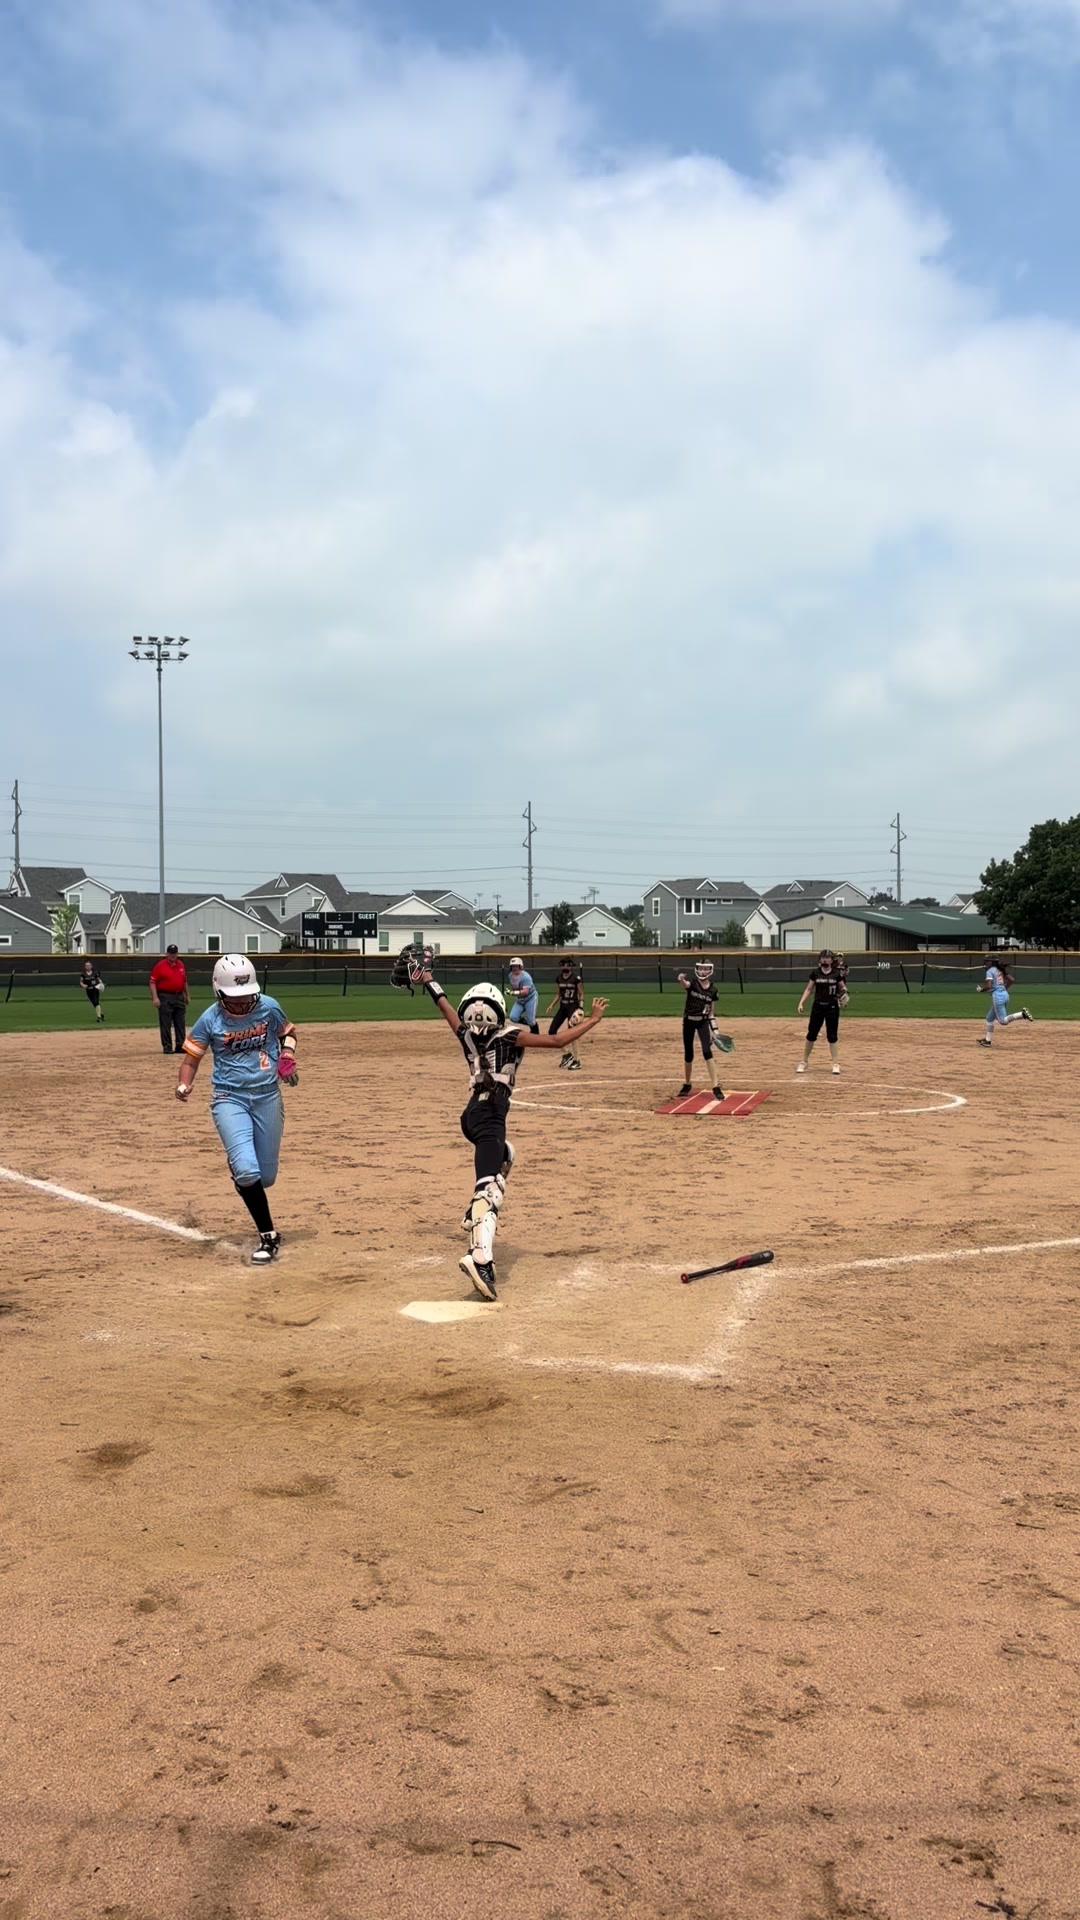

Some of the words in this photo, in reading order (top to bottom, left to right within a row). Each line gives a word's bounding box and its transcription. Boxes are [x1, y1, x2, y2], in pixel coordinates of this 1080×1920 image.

[876, 961, 890, 970] 300
[564, 989, 575, 998] 27
[223, 1021, 268, 1043] PRIME
[231, 1033, 266, 1052] CORE
[259, 1049, 272, 1070] 2
